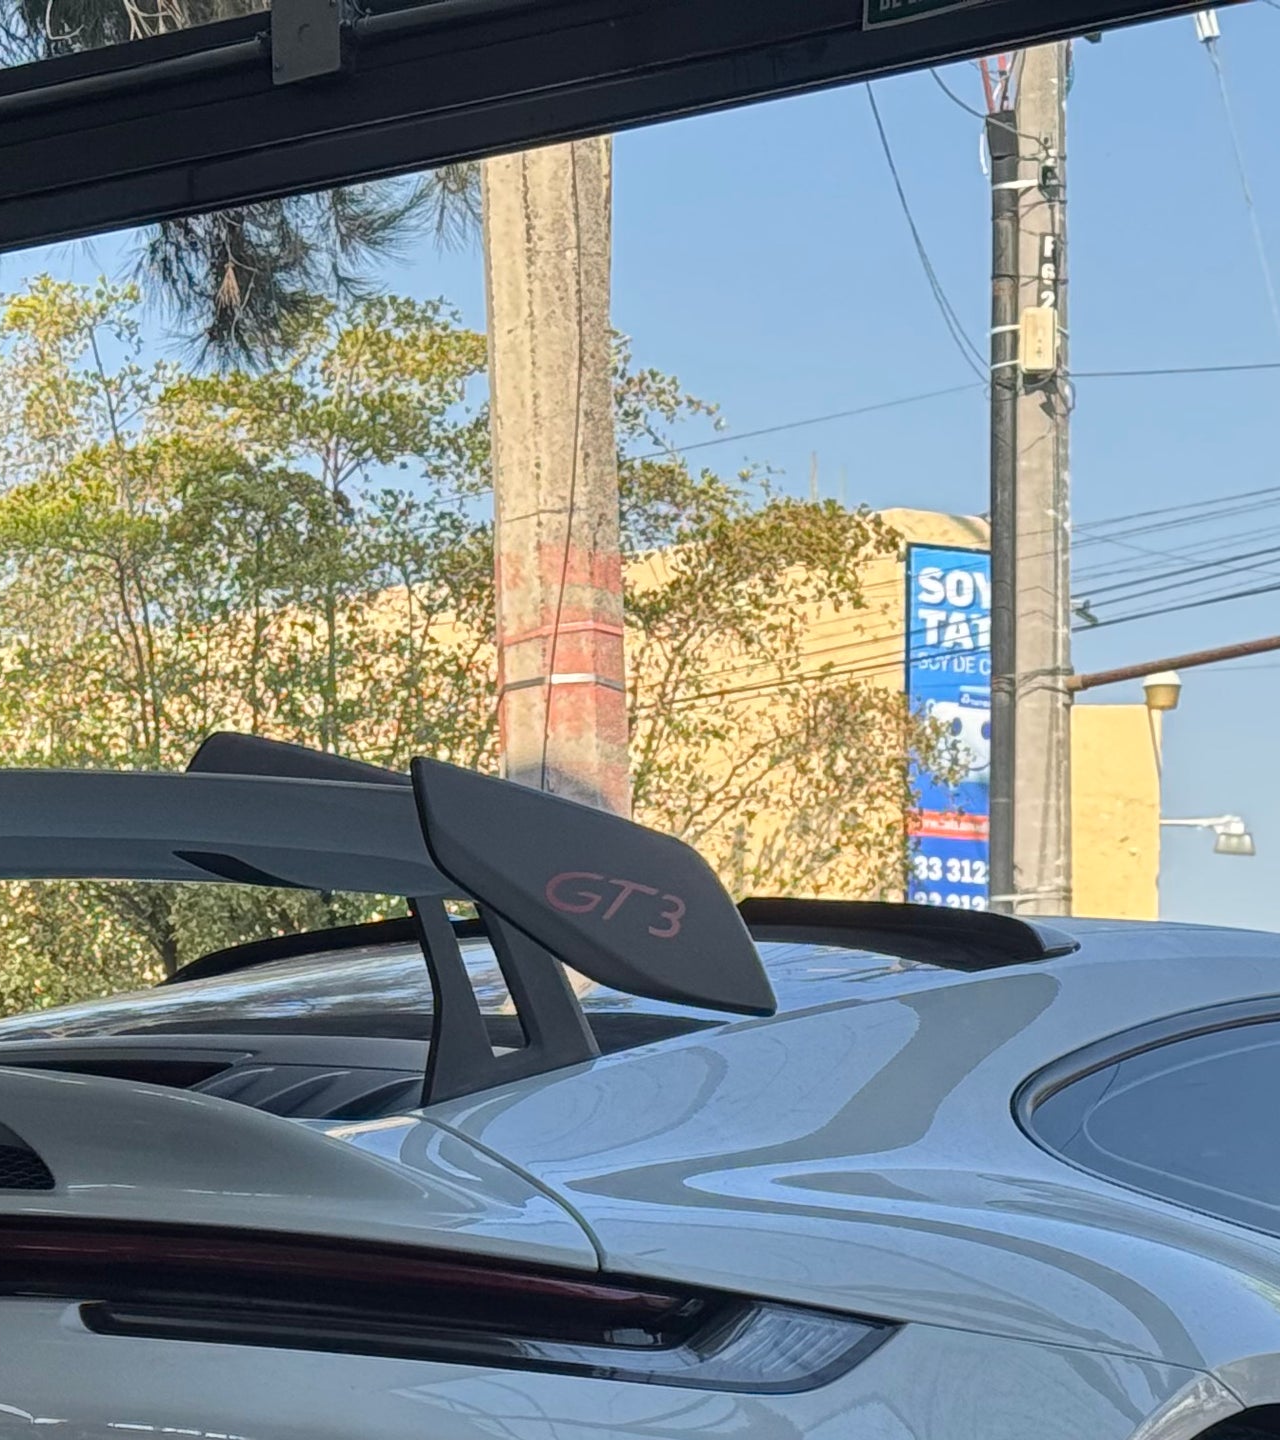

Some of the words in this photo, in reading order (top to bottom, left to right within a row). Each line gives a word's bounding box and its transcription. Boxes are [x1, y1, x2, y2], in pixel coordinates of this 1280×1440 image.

[953, 656, 976, 674] DE
[914, 855, 942, 881] 33
[946, 858, 989, 884] 312
[545, 871, 687, 938] GT3
